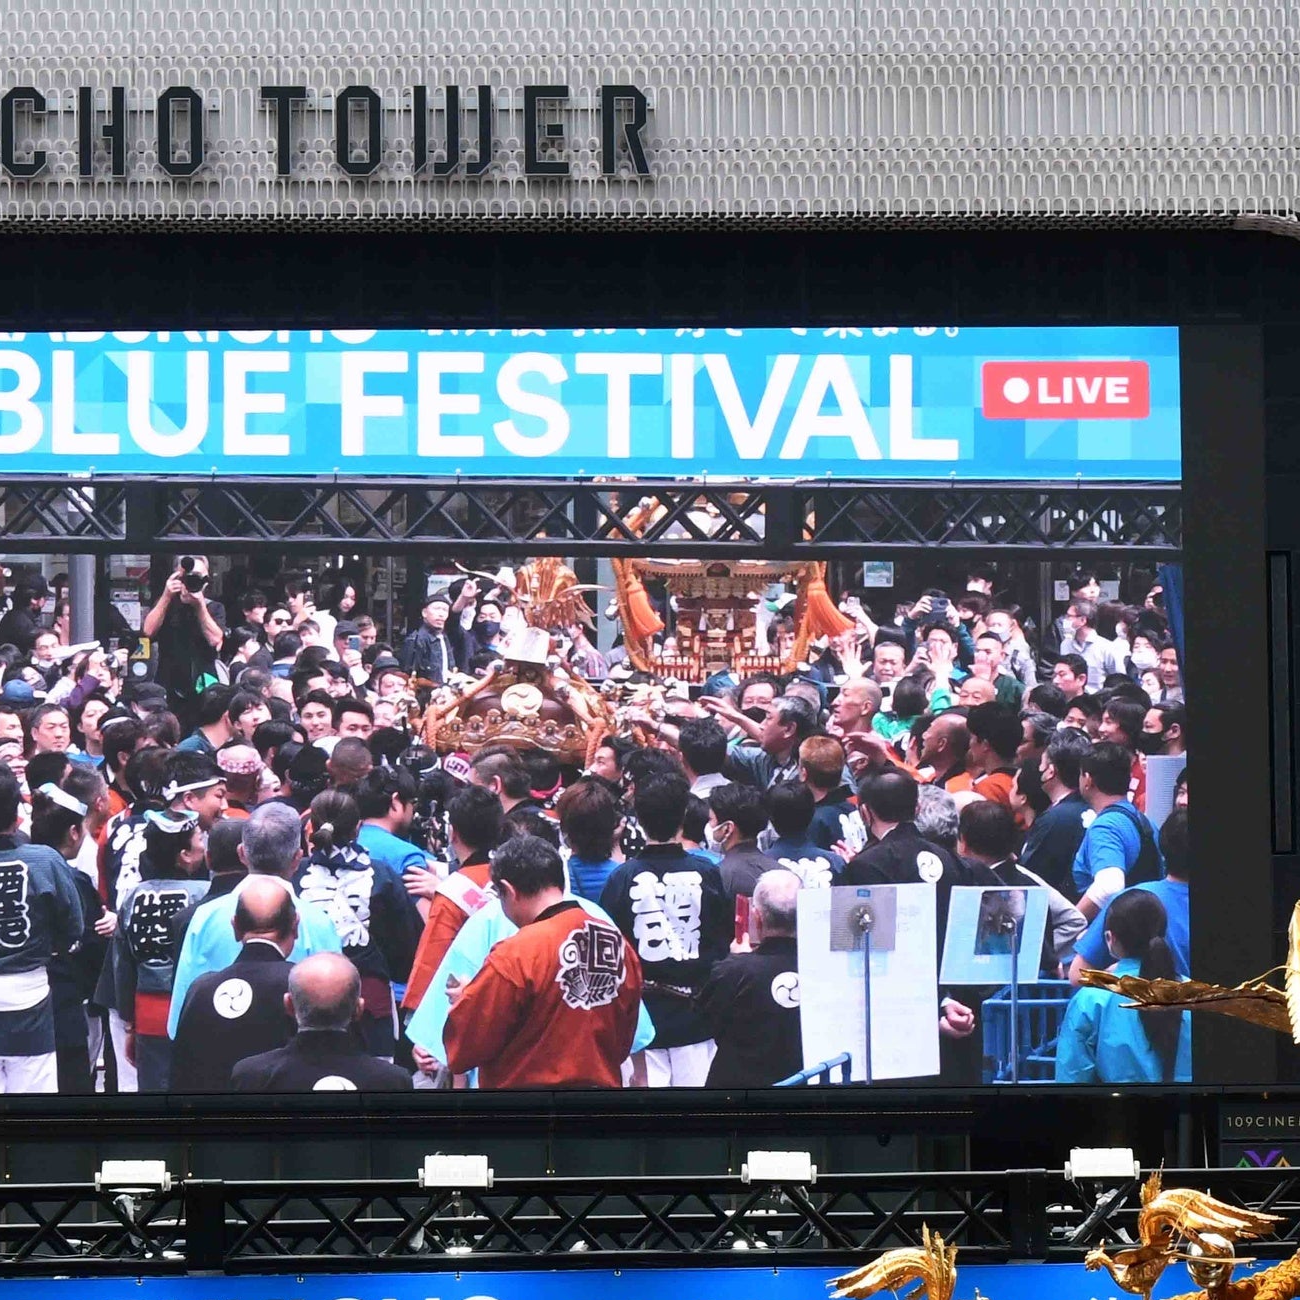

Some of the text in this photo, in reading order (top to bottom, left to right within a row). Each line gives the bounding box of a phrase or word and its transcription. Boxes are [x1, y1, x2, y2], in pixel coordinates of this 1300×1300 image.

[260, 84, 651, 178] TOWER
[340, 350, 960, 459] FESTIVAL
[1036, 376, 1131, 405] LIVE
